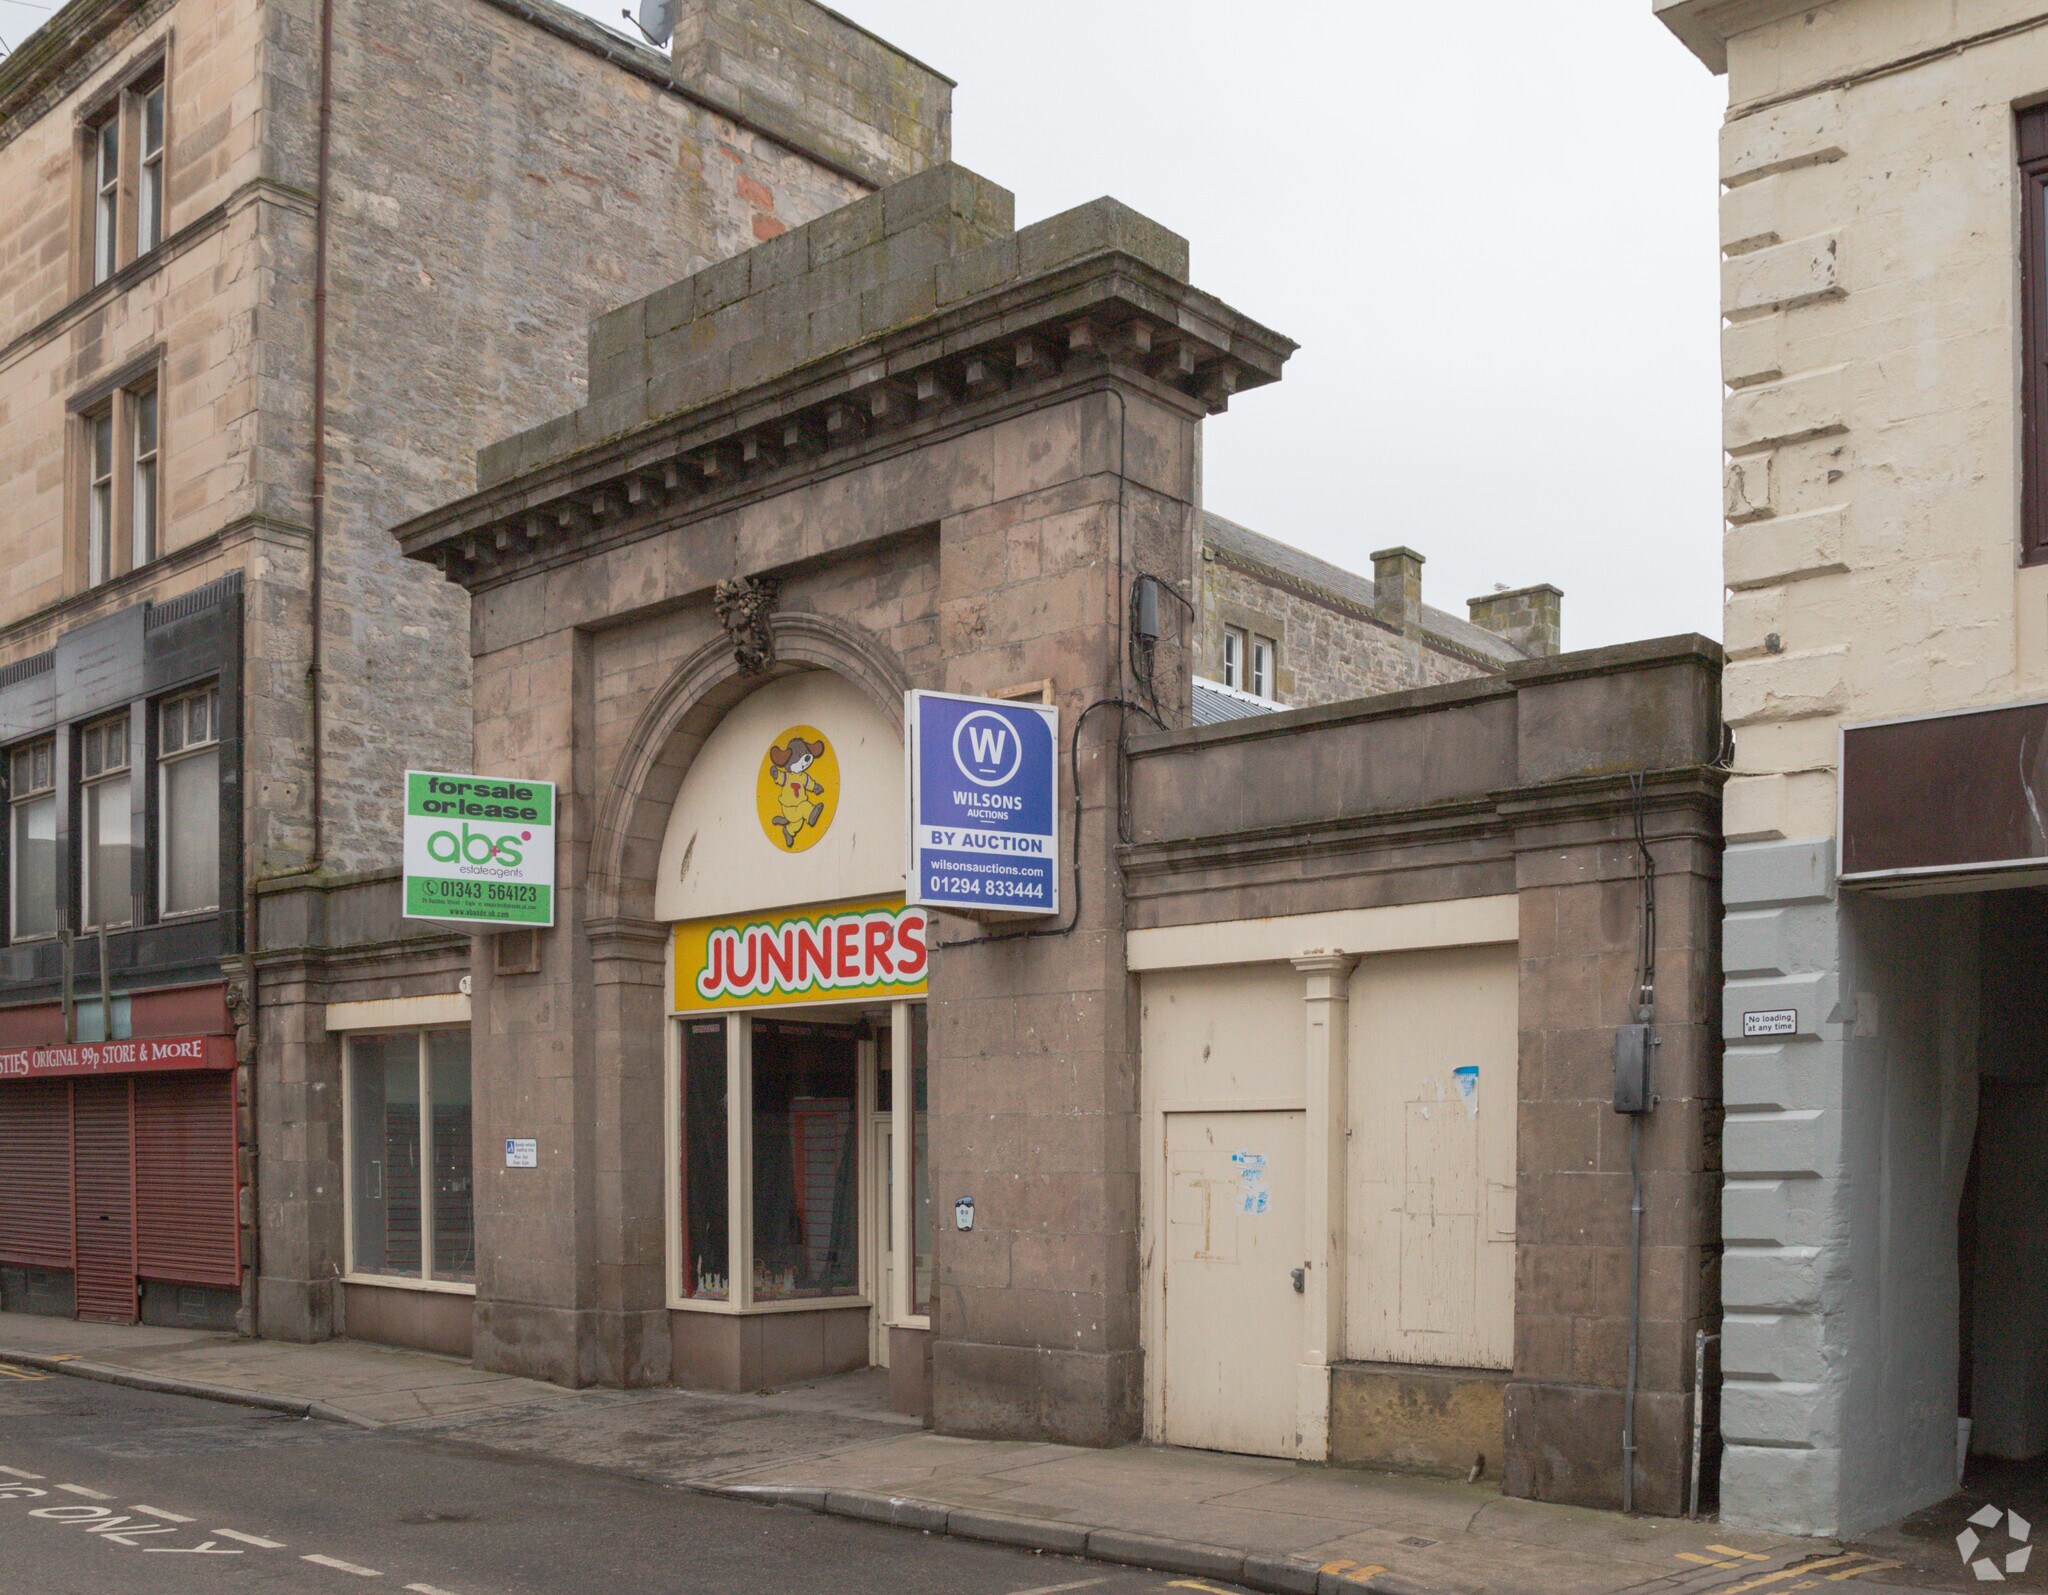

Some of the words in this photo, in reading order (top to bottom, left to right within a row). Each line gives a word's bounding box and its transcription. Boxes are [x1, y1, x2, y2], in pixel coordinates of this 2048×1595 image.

[968, 726, 1007, 765] W
[428, 777, 473, 795] for
[474, 783, 533, 801] sale
[423, 799, 457, 813] or
[458, 799, 538, 820] lease
[953, 791, 1022, 810] WILSONS
[967, 809, 1009, 821] AUCTIONS
[931, 831, 956, 846] BY
[961, 834, 1043, 853] AUCTION
[931, 859, 1044, 877] wilsonsauctions.com
[441, 880, 482, 899] 01343
[488, 885, 537, 902] 564123
[930, 876, 981, 895] 01294
[985, 880, 1044, 899] 833444
[702, 916, 927, 990] JUNNERS
[1762, 1014, 1792, 1023] loading
[32, 1048, 79, 1069] ORIGINAL
[81, 1047, 100, 1070] 99p
[102, 1044, 136, 1064] STORE
[139, 1043, 148, 1061] &
[151, 1040, 202, 1061] MORE
[28, 1505, 245, 1554] ONLY
